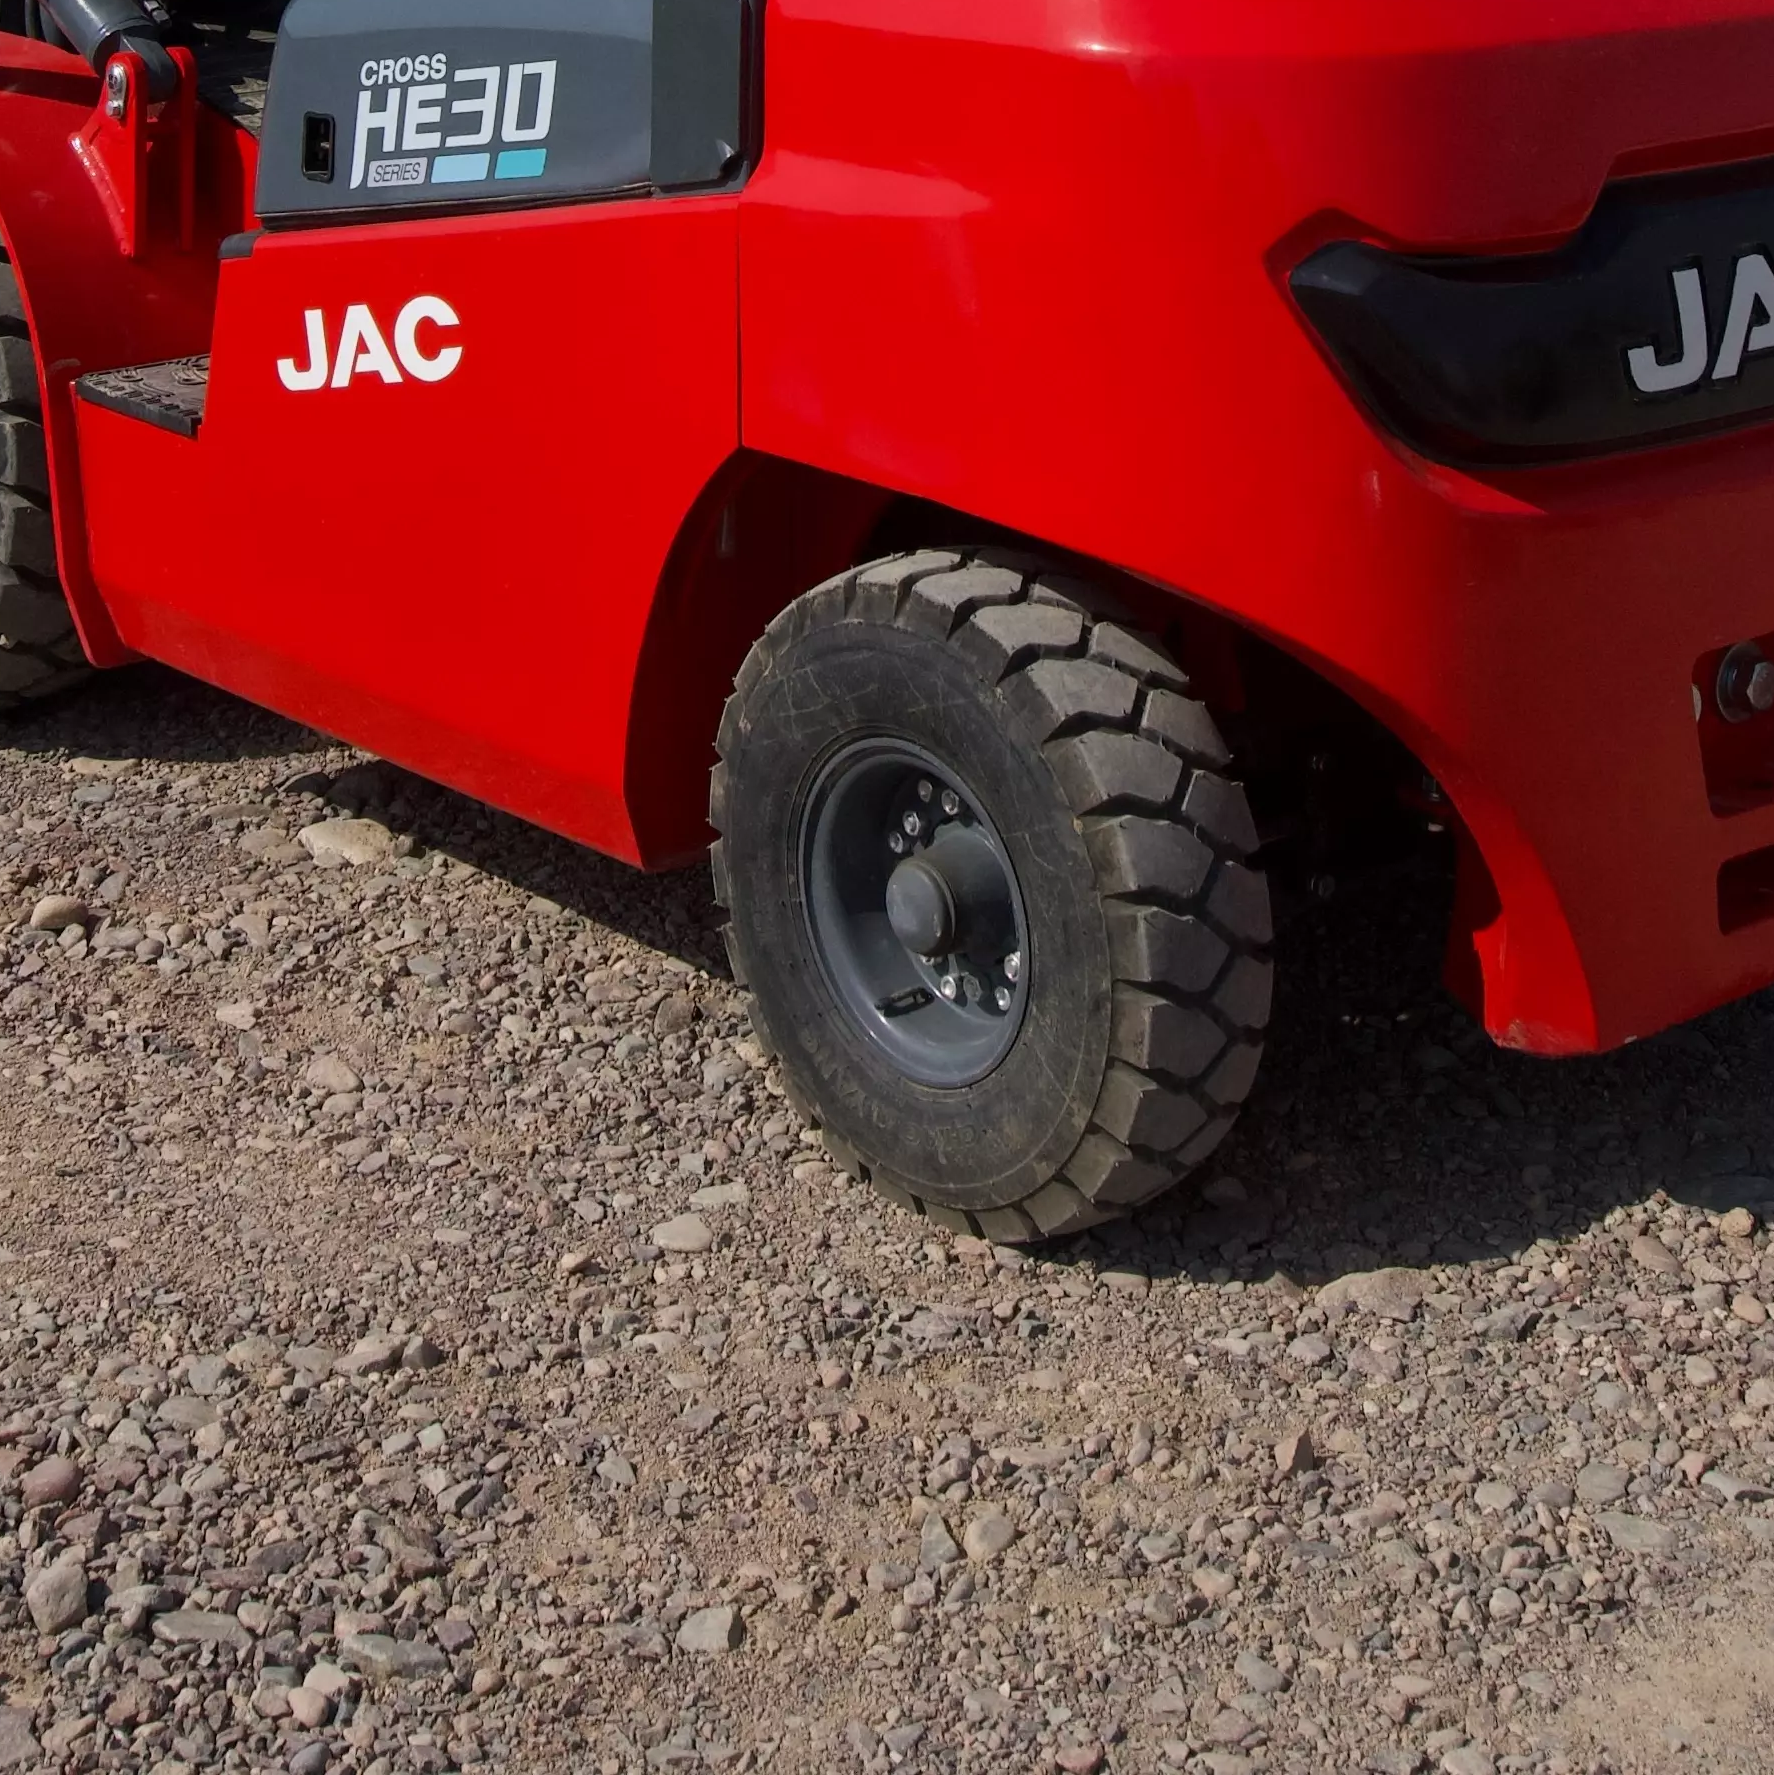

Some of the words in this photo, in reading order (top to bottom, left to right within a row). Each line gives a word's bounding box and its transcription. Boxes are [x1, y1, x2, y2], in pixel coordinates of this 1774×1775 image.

[360, 53, 447, 86] CROSS
[349, 60, 557, 189] HE30
[373, 162, 421, 183] SERIES
[277, 296, 463, 392] JAC
